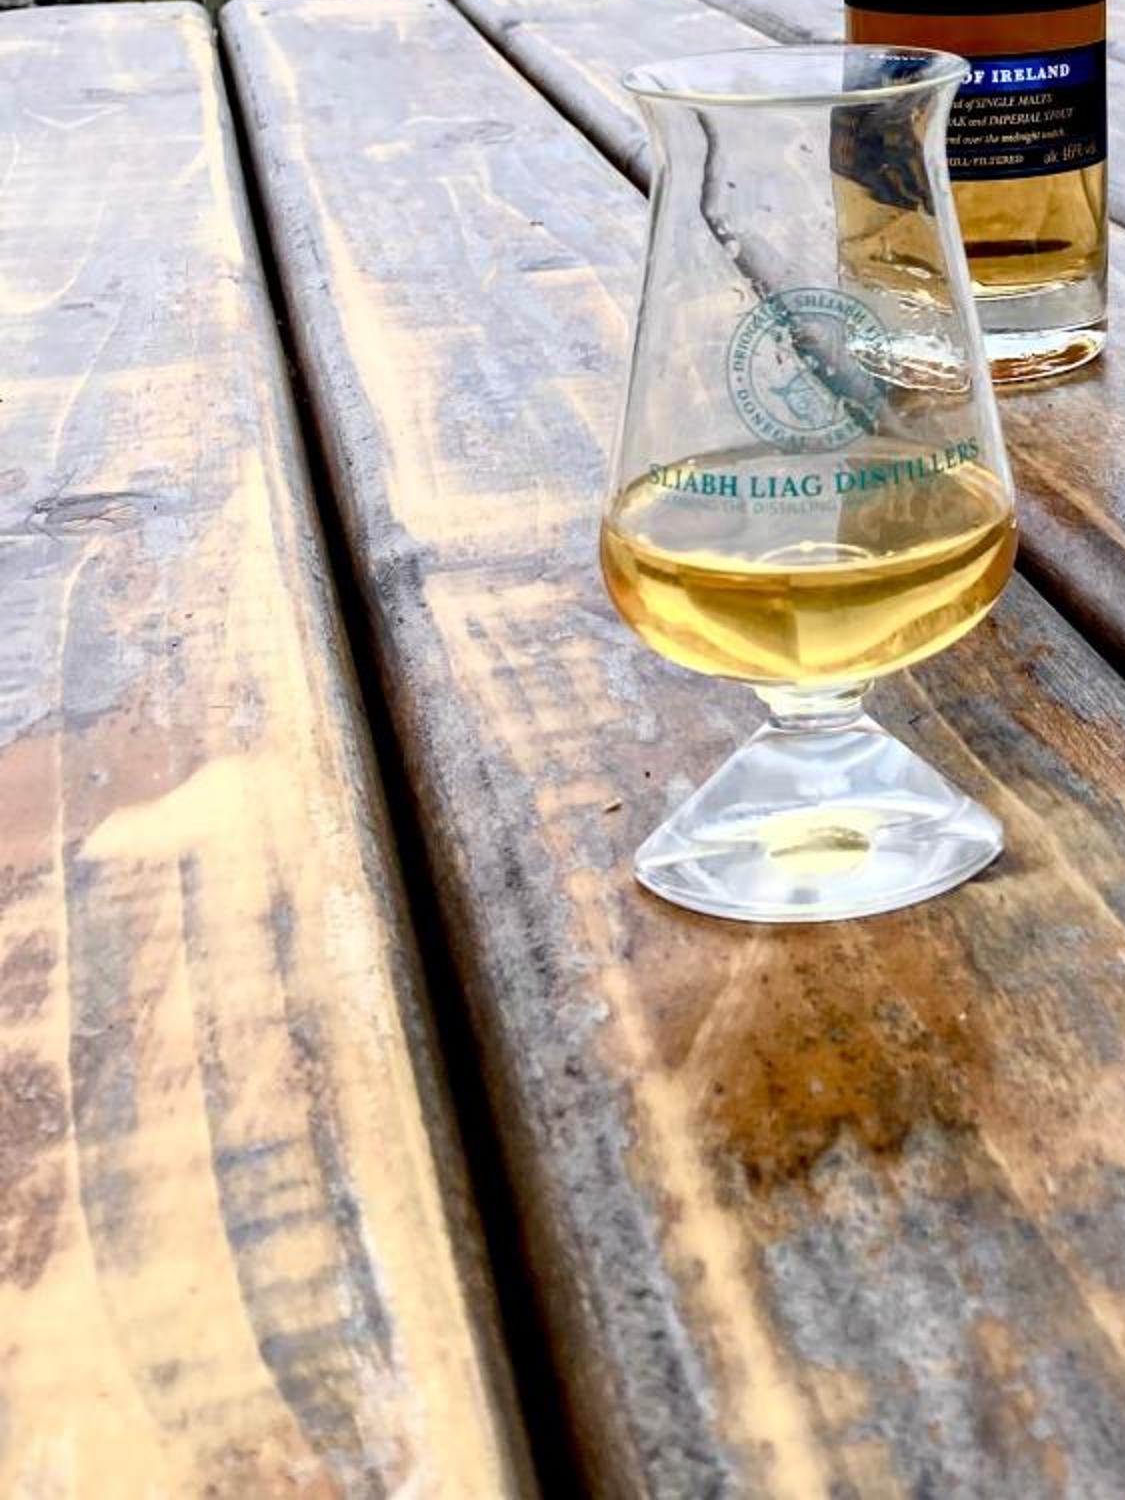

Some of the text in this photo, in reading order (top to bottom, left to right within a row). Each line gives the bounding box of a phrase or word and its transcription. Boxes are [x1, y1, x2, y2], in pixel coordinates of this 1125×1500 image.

[962, 64, 1071, 84] OF IRELAND
[974, 96, 1014, 109] SINGLE
[1017, 93, 1054, 106] MALTS
[968, 115, 988, 127] and
[988, 113, 1041, 126] IMPERIAL
[649, 462, 738, 497] SLIABH
[750, 474, 823, 499] LIAG
[836, 436, 980, 495] DISTILLERS
